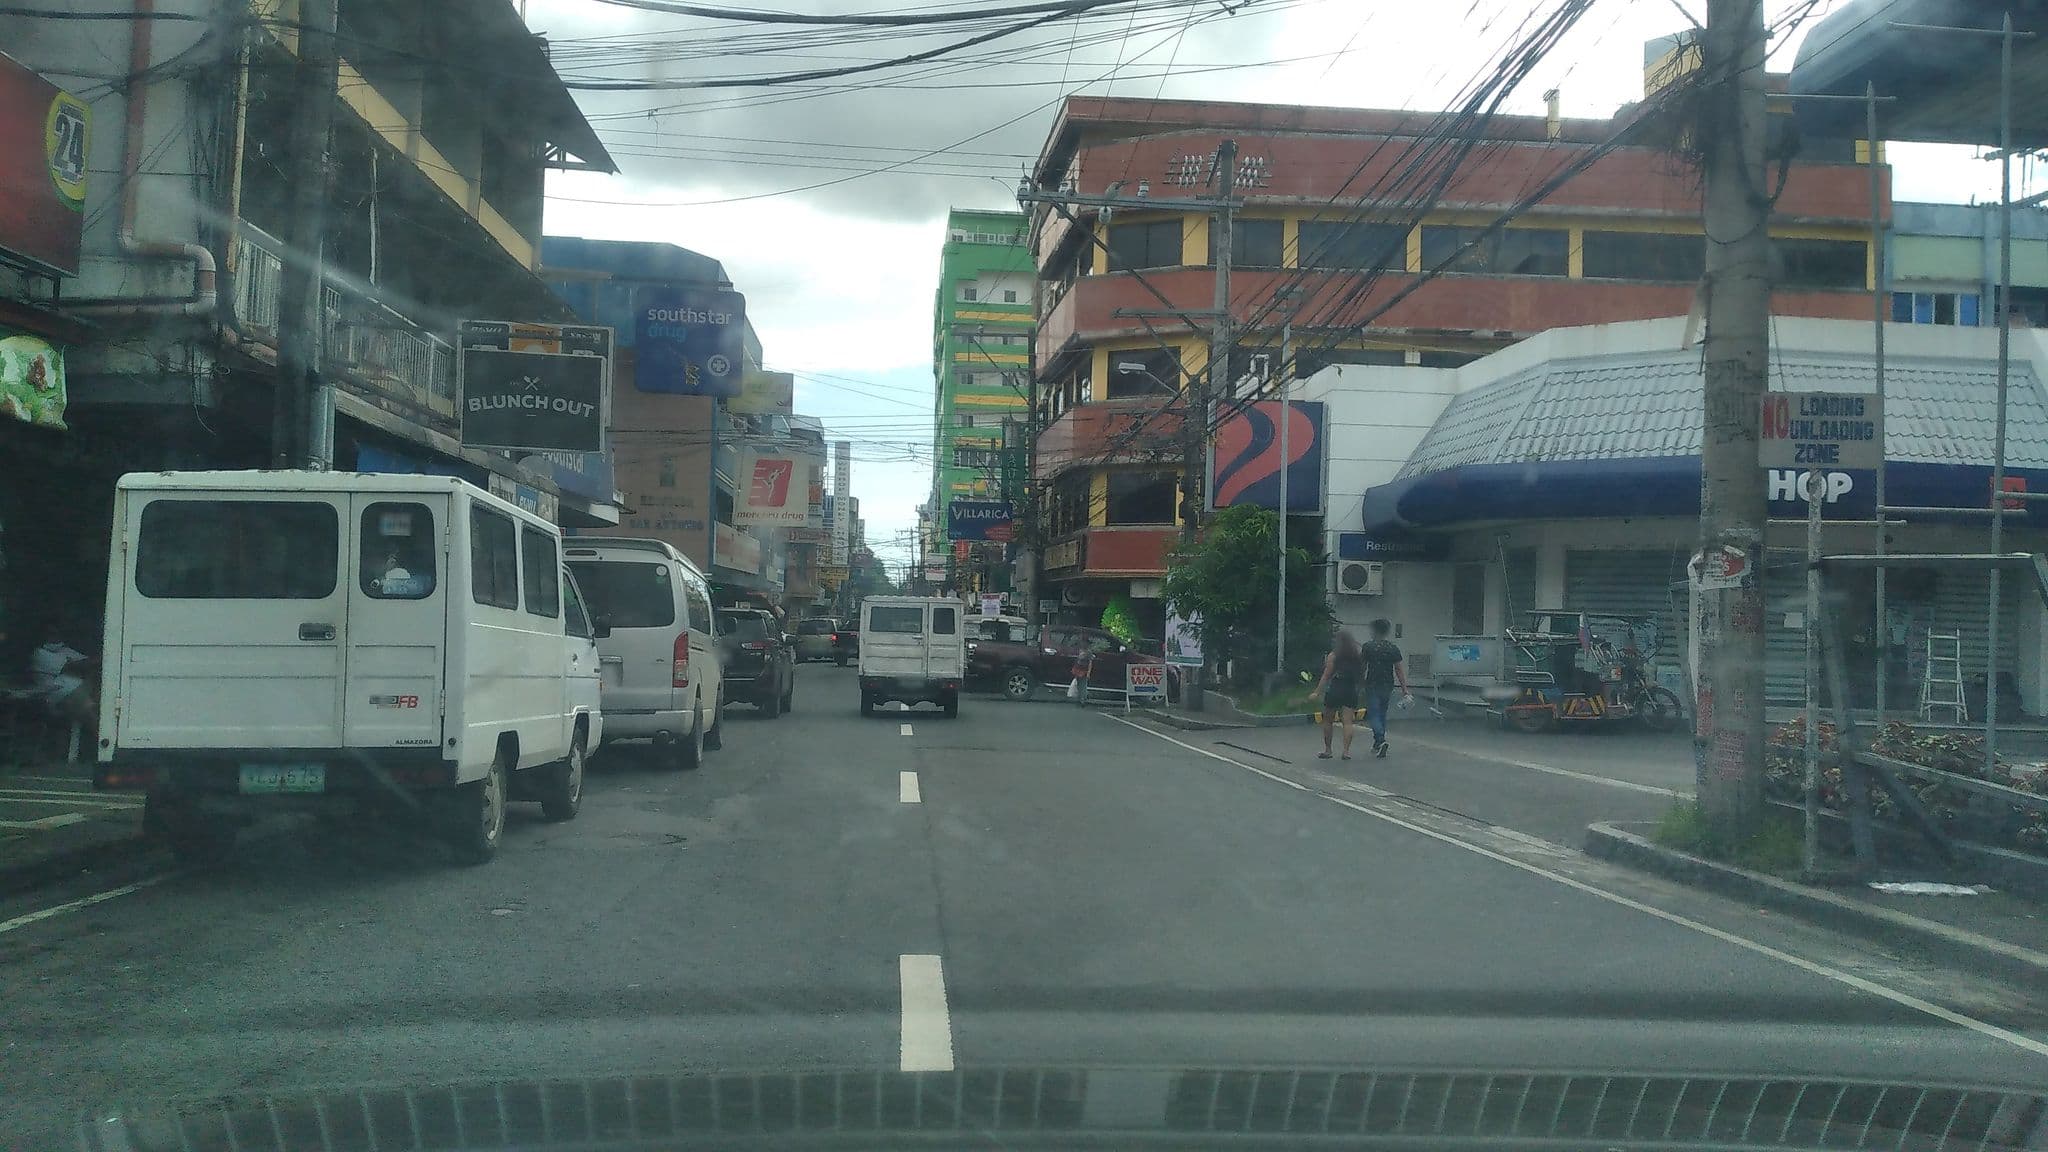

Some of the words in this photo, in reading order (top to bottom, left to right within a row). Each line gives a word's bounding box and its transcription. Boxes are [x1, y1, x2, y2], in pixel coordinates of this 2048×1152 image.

[53, 113, 85, 177] 24
[647, 307, 732, 325] southstar
[648, 321, 687, 343] drug
[468, 394, 549, 412] BLUNCH
[552, 398, 595, 418] OUT
[1762, 396, 1789, 439] NO
[1790, 420, 1875, 441] UNLOADING
[1795, 443, 1840, 464] ZONE
[1768, 469, 1853, 503] HOP
[952, 506, 1010, 520] VILLARICA
[1131, 667, 1162, 676] ONE
[1131, 676, 1163, 685] WAY
[399, 695, 419, 709] FB
